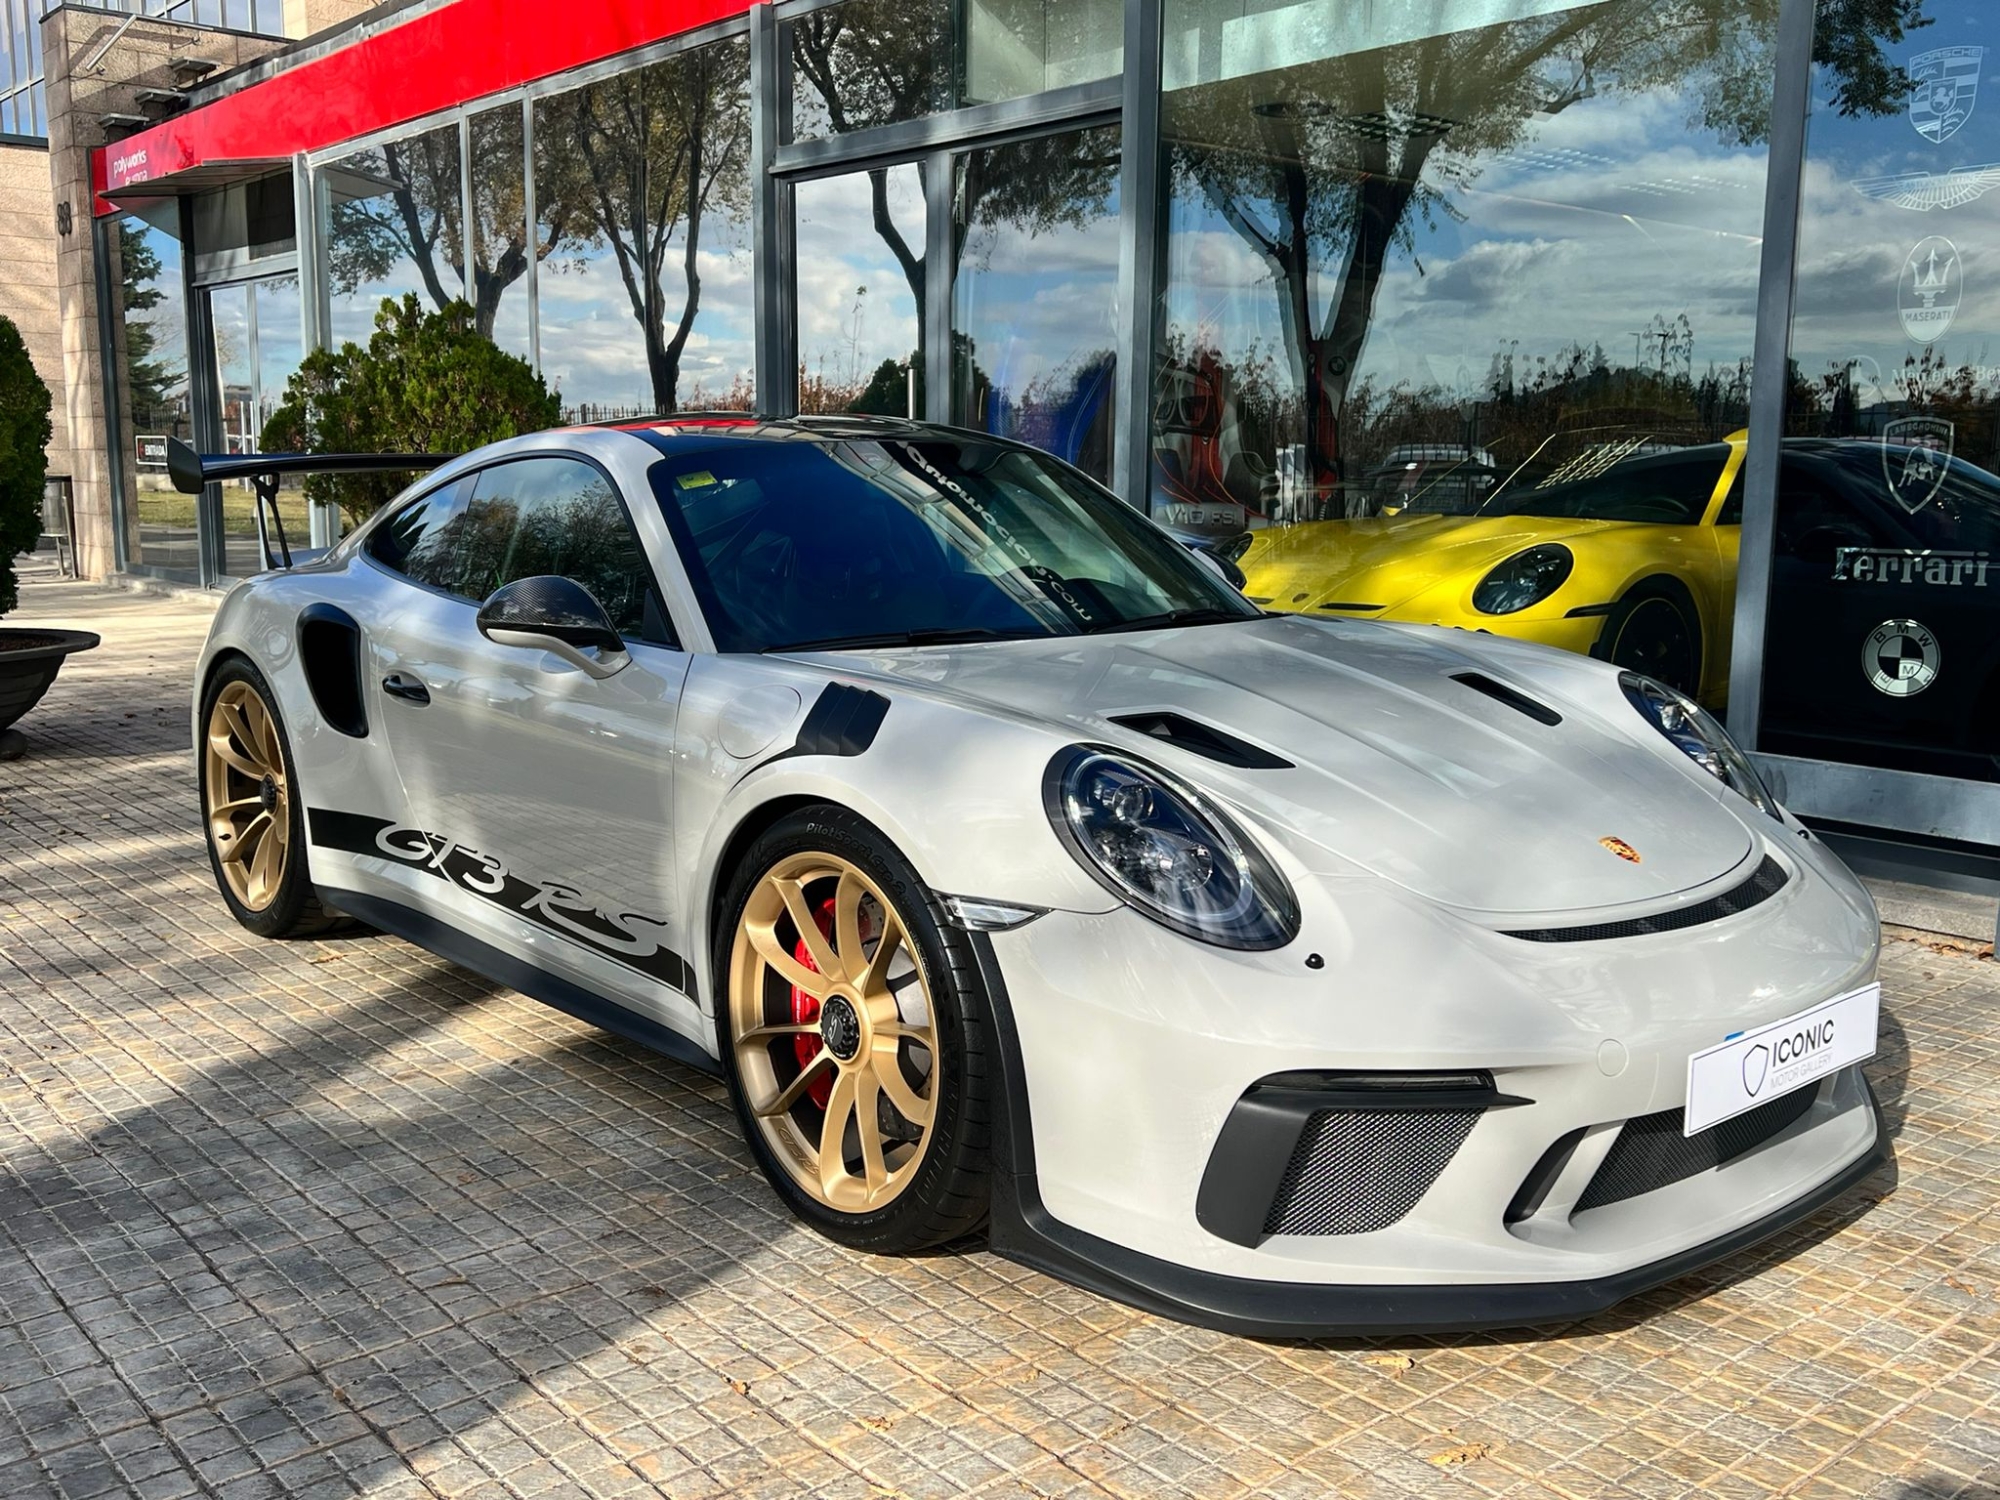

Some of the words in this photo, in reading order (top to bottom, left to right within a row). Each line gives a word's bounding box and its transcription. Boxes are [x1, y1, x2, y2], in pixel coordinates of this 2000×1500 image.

[1911, 48, 1980, 68] PORSCHE
[113, 149, 147, 179] polyworks
[1905, 310, 1950, 323] MASERATI
[1831, 548, 1990, 586] Ferrari
[1873, 623, 1933, 648] BMW
[805, 822, 836, 837] Pilot
[835, 829, 873, 859] Sport
[375, 823, 510, 894] GT3
[520, 881, 668, 957] RS
[1772, 1019, 1835, 1068] ICONIC
[1770, 1066, 1800, 1089] MOTOR
[1800, 1053, 1833, 1078] GALLERY
